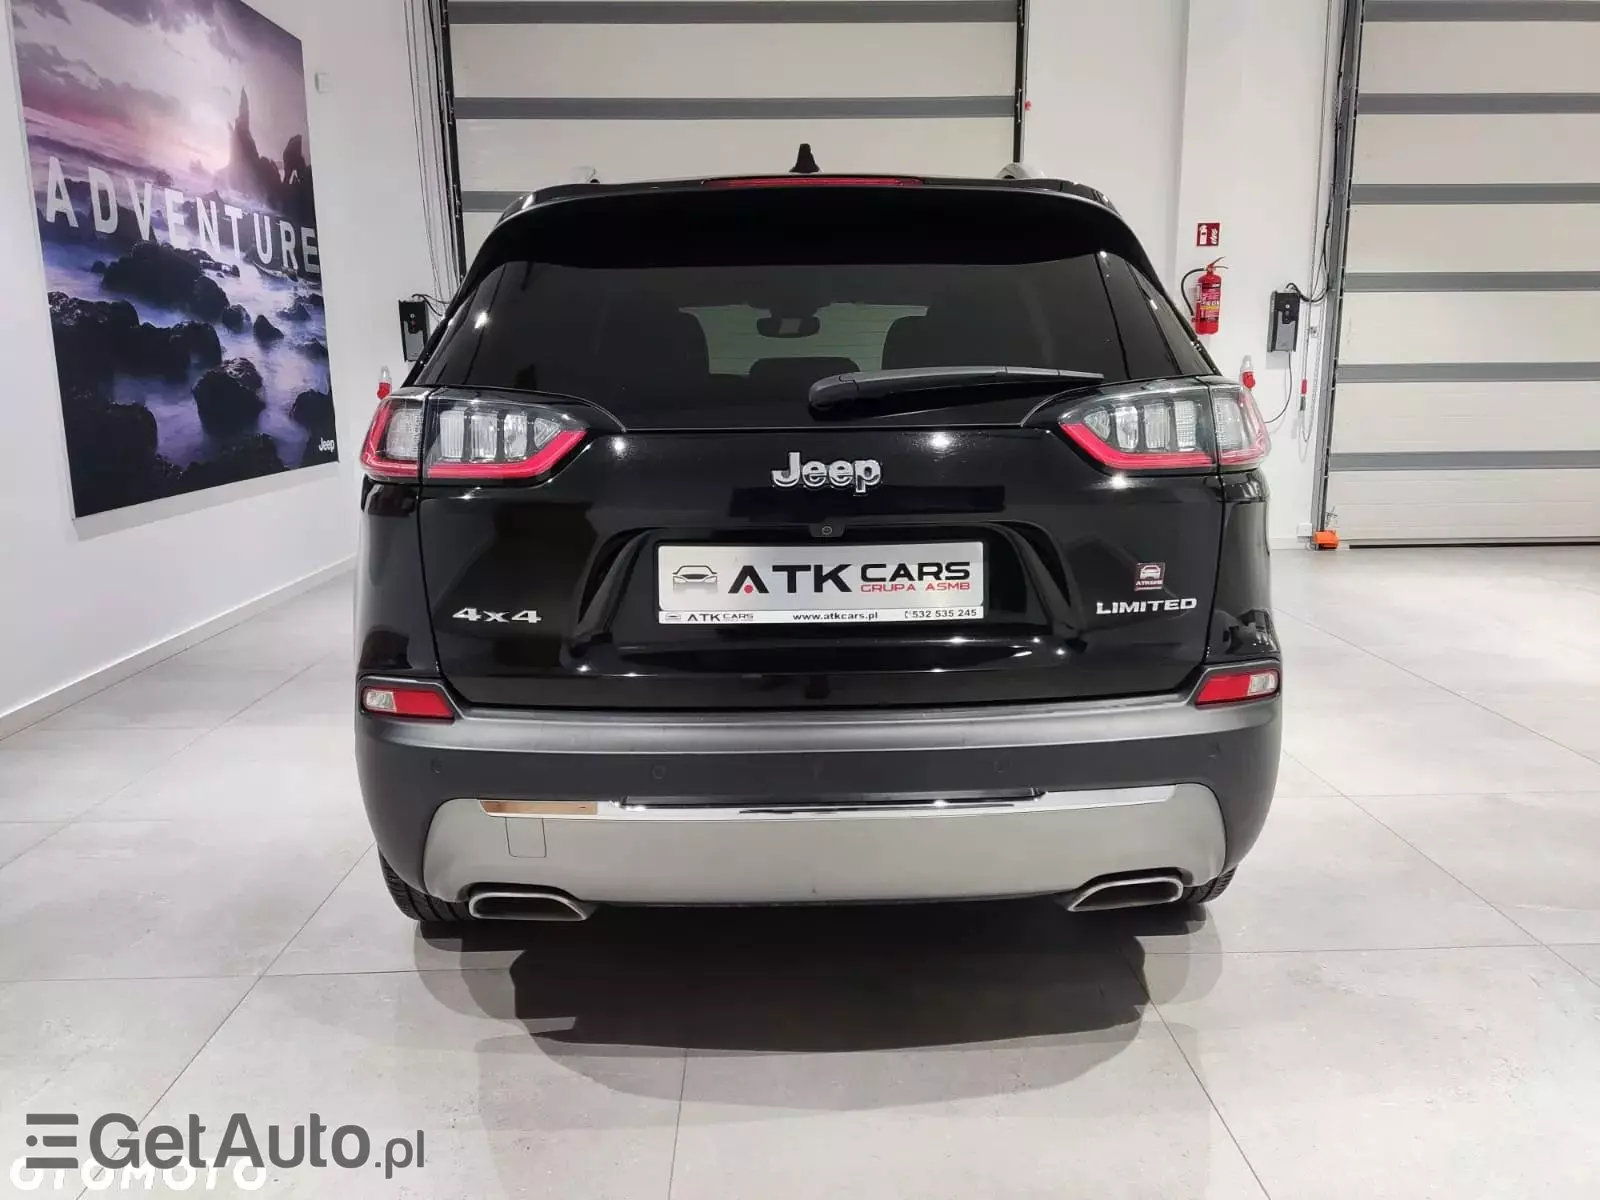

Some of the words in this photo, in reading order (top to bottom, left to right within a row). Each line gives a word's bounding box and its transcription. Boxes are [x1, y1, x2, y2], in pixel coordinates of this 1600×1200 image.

[46, 156, 320, 274] ADVENTURE
[318, 436, 335, 453] Jeep
[771, 451, 882, 494] Jeep
[727, 563, 853, 594] ATK
[860, 561, 971, 582] CARS
[860, 583, 917, 593] GRUPA
[925, 582, 971, 592] ASMB
[912, 610, 932, 619] 532
[935, 609, 954, 618] 535
[957, 609, 977, 617] 245
[1095, 597, 1198, 615] LIMITED
[452, 607, 542, 624] 4x4
[687, 613, 721, 622] ATK
[722, 612, 754, 620] CARS
[792, 611, 879, 622] www.atkcars.pl
